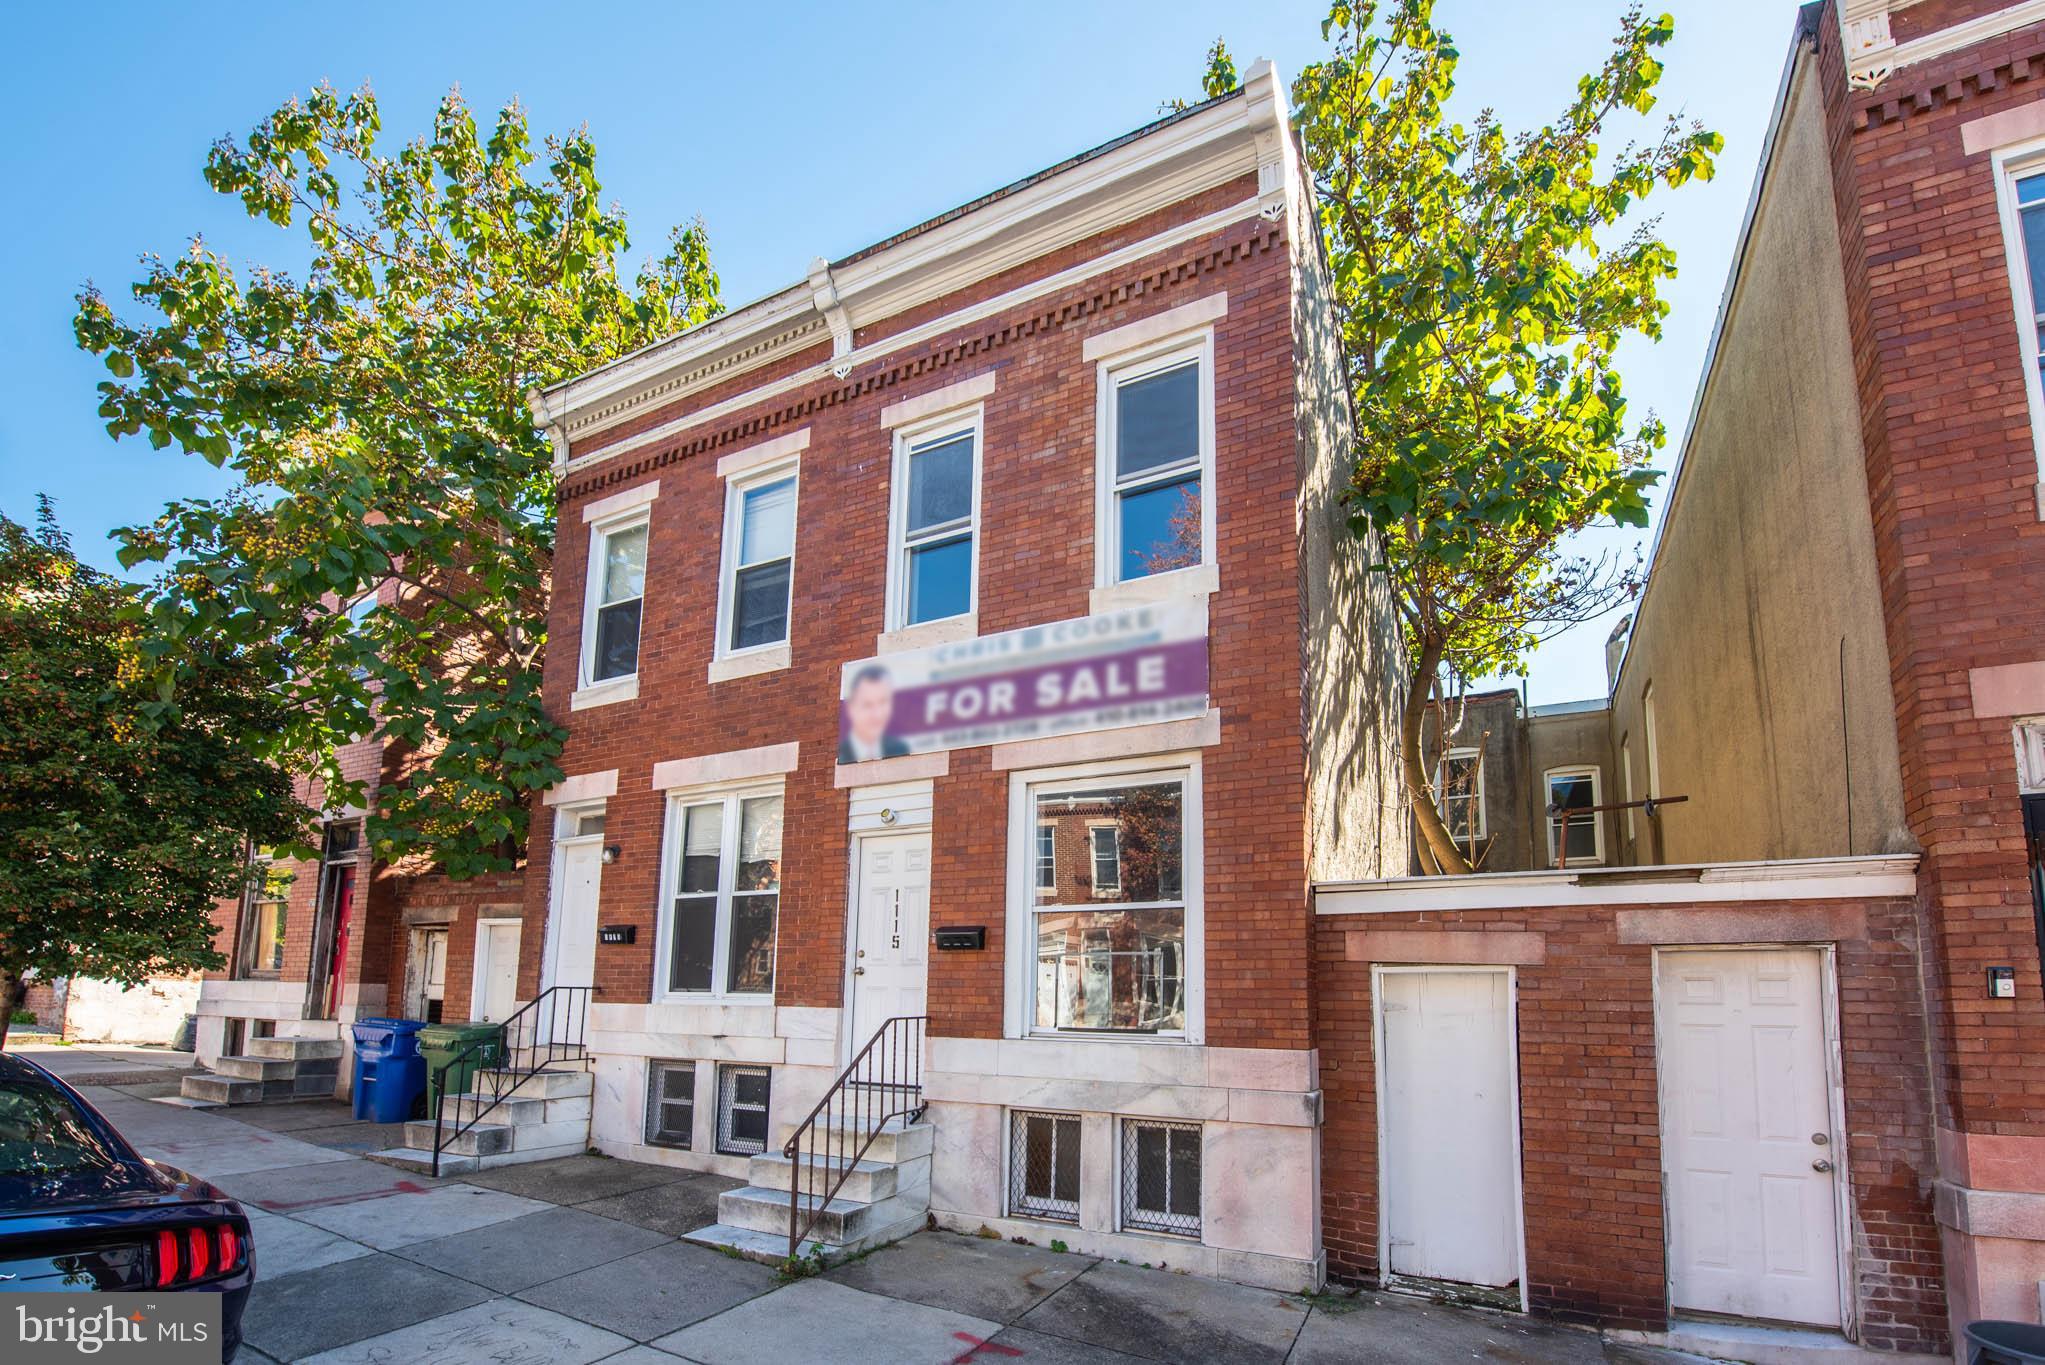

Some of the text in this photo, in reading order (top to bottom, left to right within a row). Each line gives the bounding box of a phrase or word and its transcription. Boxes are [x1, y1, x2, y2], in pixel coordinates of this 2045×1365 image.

[924, 681, 1018, 725] FOR
[1035, 655, 1167, 709] SALE
[892, 889, 900, 949] 1115
